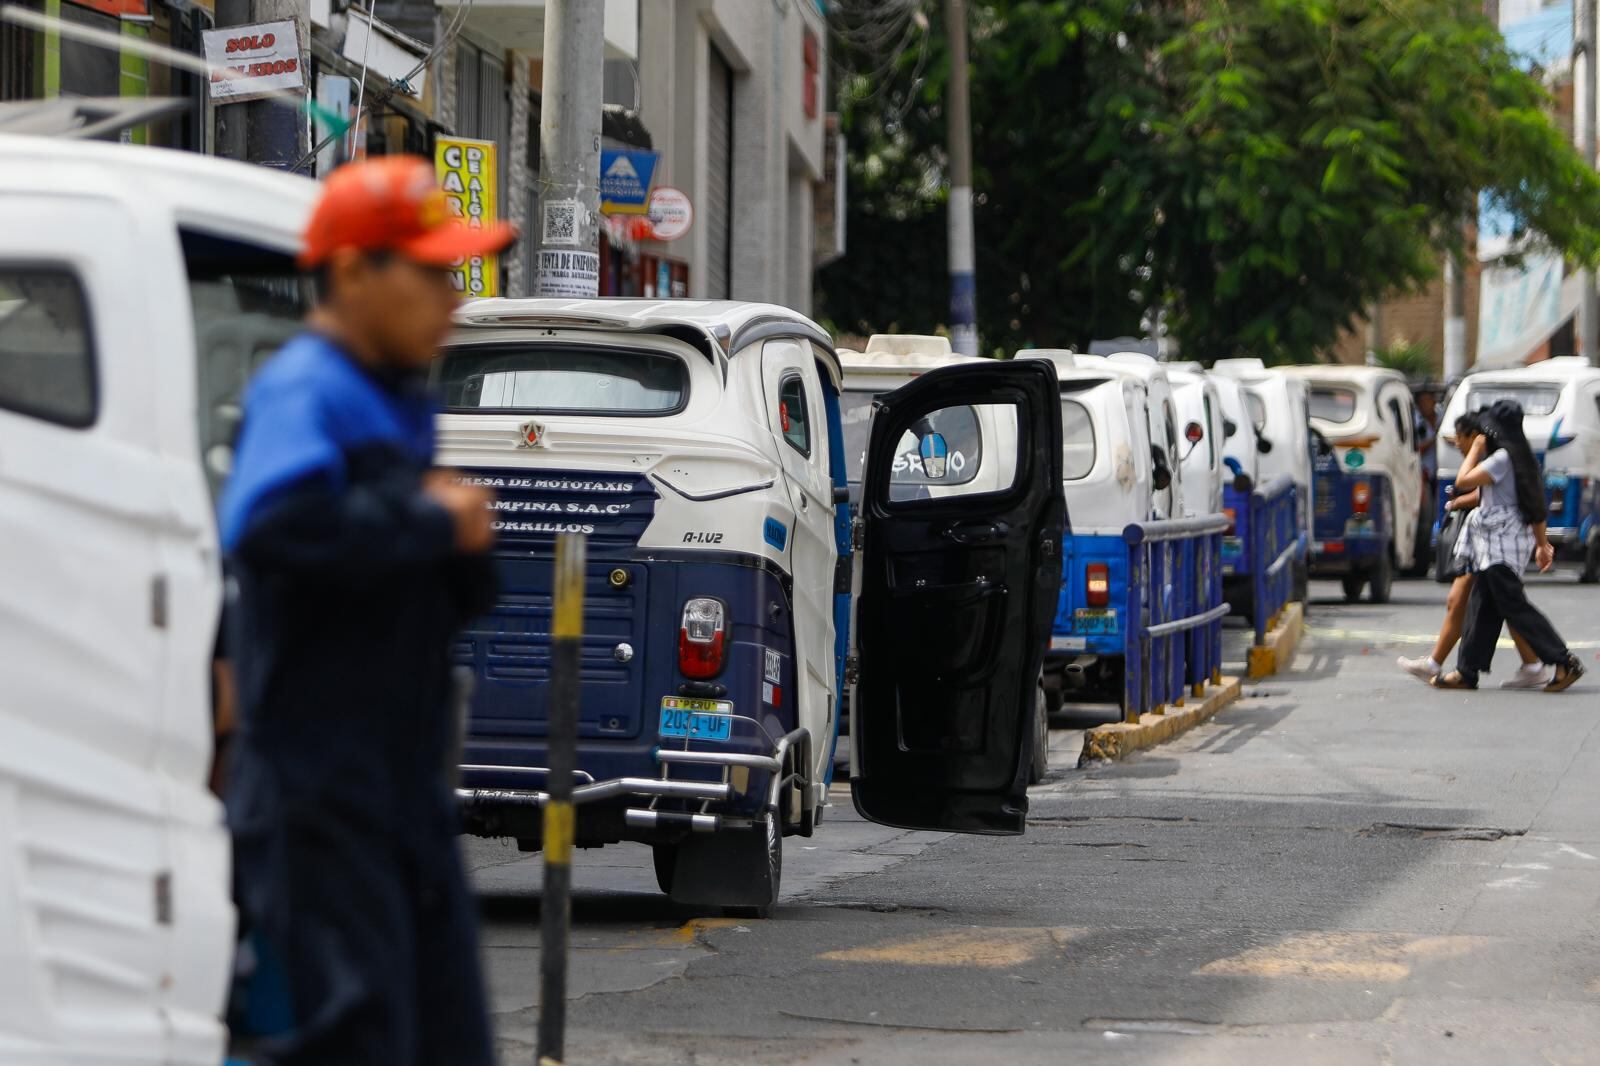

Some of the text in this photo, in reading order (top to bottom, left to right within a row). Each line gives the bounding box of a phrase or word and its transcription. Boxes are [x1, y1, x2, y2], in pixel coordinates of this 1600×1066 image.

[226, 33, 275, 53] SOLO
[561, 254, 571, 270] DE
[508, 479, 532, 488] DE
[535, 480, 633, 492] MOTOTAXIS
[490, 521, 594, 534] ORRILLOS
[682, 701, 711, 710] PERU
